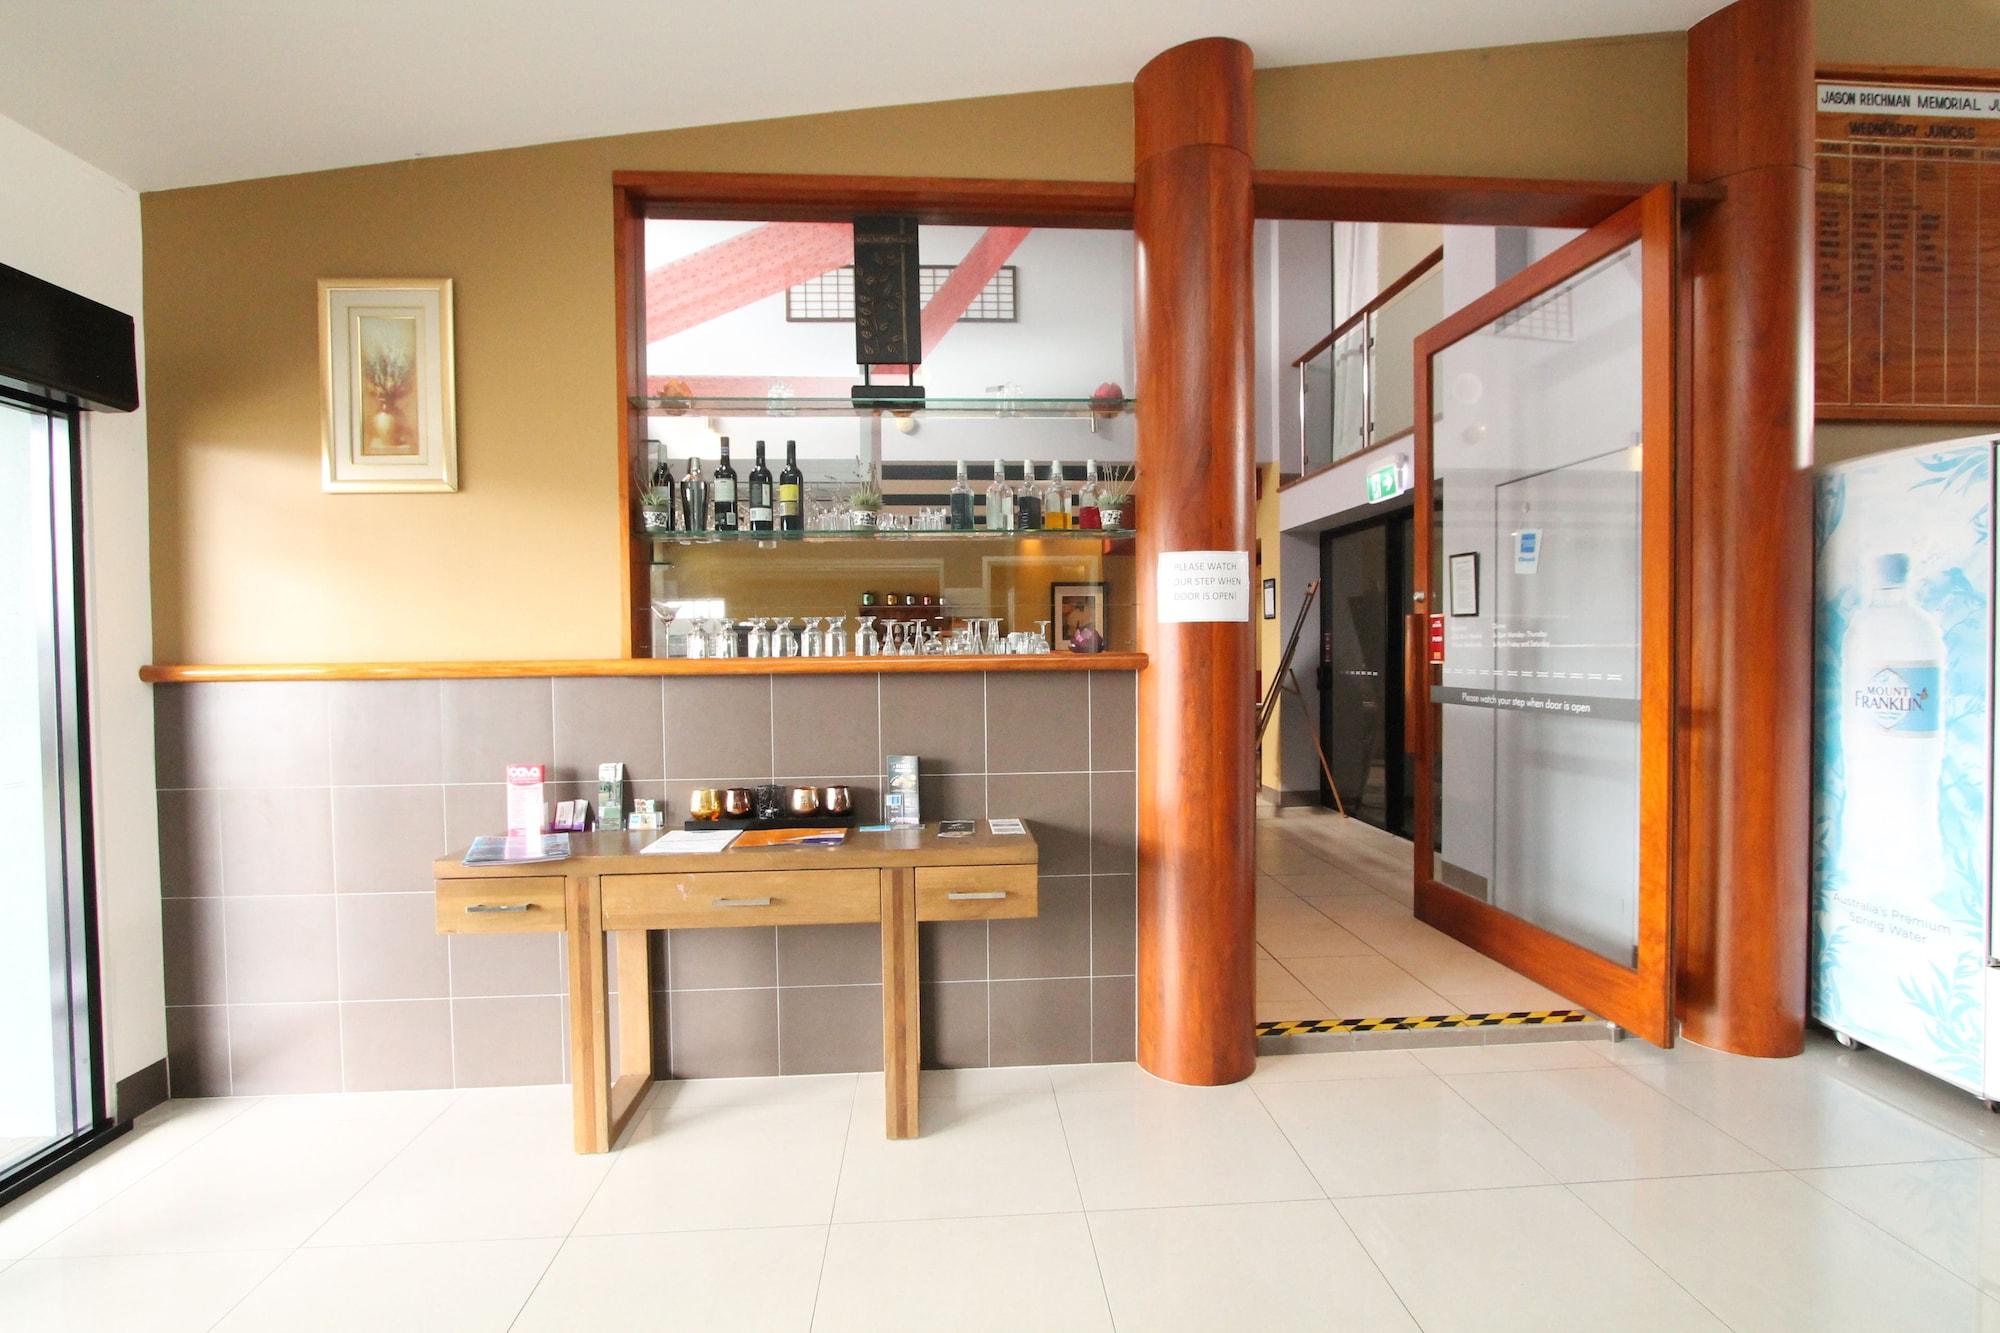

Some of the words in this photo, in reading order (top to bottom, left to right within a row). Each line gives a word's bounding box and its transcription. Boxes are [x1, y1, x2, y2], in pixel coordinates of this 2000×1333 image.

[1821, 90, 1856, 105] JASON
[1859, 92, 1911, 108] REICHMAN
[1917, 94, 1982, 112] MEMORIAL
[1849, 121, 1918, 137] WEDNESDAY
[1923, 123, 1977, 140] JUNIORS
[1174, 561, 1204, 571] PLEASE
[1207, 561, 1237, 571] WATCH
[1194, 577, 1216, 586] STEP
[1217, 577, 1242, 586] WHEN
[1174, 591, 1200, 601] DOOR
[1202, 591, 1210, 601] IS
[1855, 690, 1925, 712] FRANKLIN
[1866, 686, 1909, 697] MOUNT
[1461, 691, 1479, 703] Please
[1480, 693, 1496, 704] watch
[1497, 696, 1511, 707] your
[1512, 697, 1525, 708] step
[1526, 697, 1544, 708] when
[1545, 698, 1562, 710] door
[1563, 700, 1570, 711] is
[1571, 702, 1591, 713] open
[1833, 892, 1888, 918] Australia's
[1890, 909, 1952, 935] Premium
[1848, 911, 1886, 932] Spring
[1889, 924, 1928, 944] Water
